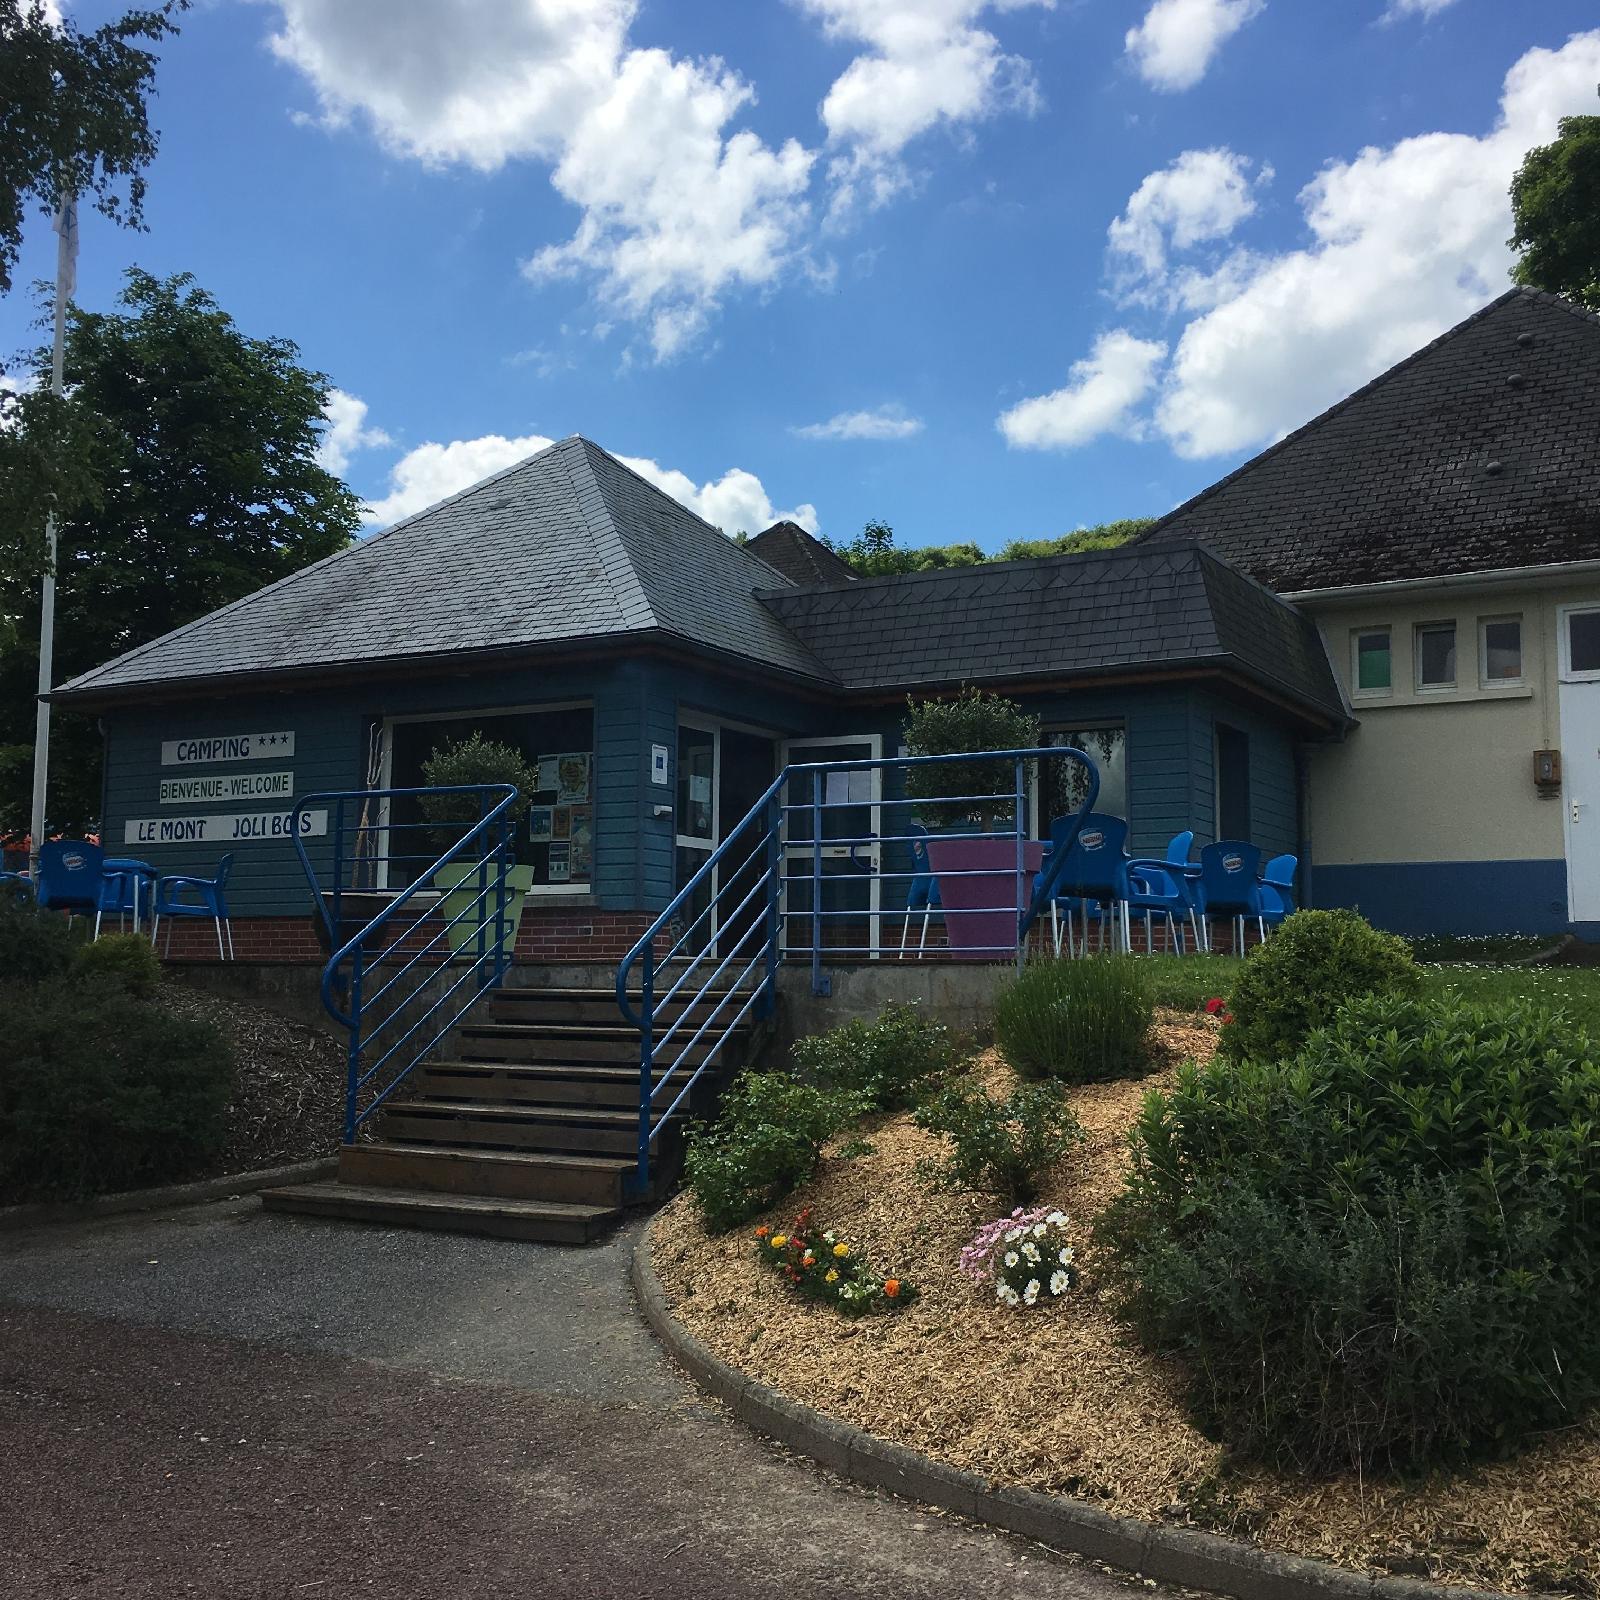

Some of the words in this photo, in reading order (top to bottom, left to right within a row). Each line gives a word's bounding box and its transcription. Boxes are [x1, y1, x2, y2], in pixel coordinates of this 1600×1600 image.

[177, 737, 250, 761] CAMPING
[138, 822, 156, 841] LE
[160, 820, 207, 840] MONT
[232, 816, 266, 838] JOLI
[271, 812, 312, 835] BOS
